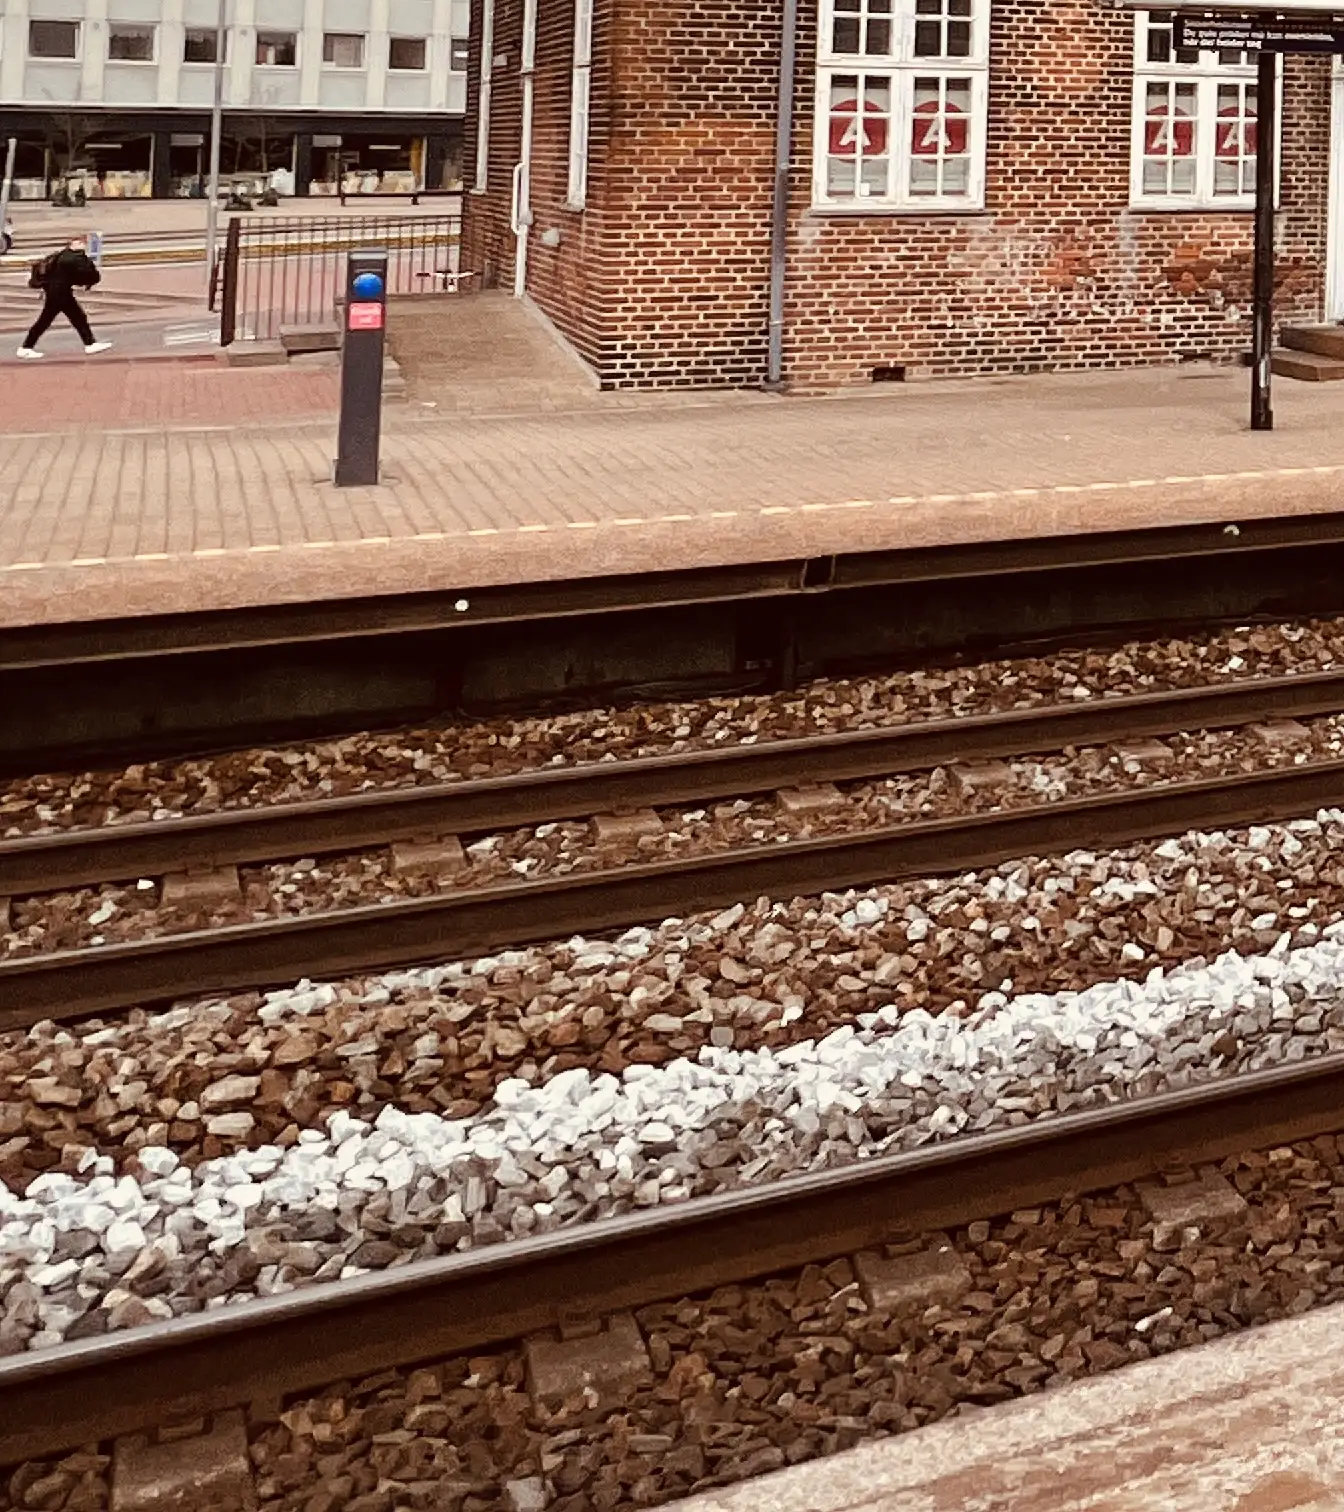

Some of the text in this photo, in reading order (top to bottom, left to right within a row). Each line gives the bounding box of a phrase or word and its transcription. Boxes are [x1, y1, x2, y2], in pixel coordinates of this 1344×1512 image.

[838, 113, 872, 147] A
[920, 113, 952, 147] A
[1151, 118, 1180, 149] A
